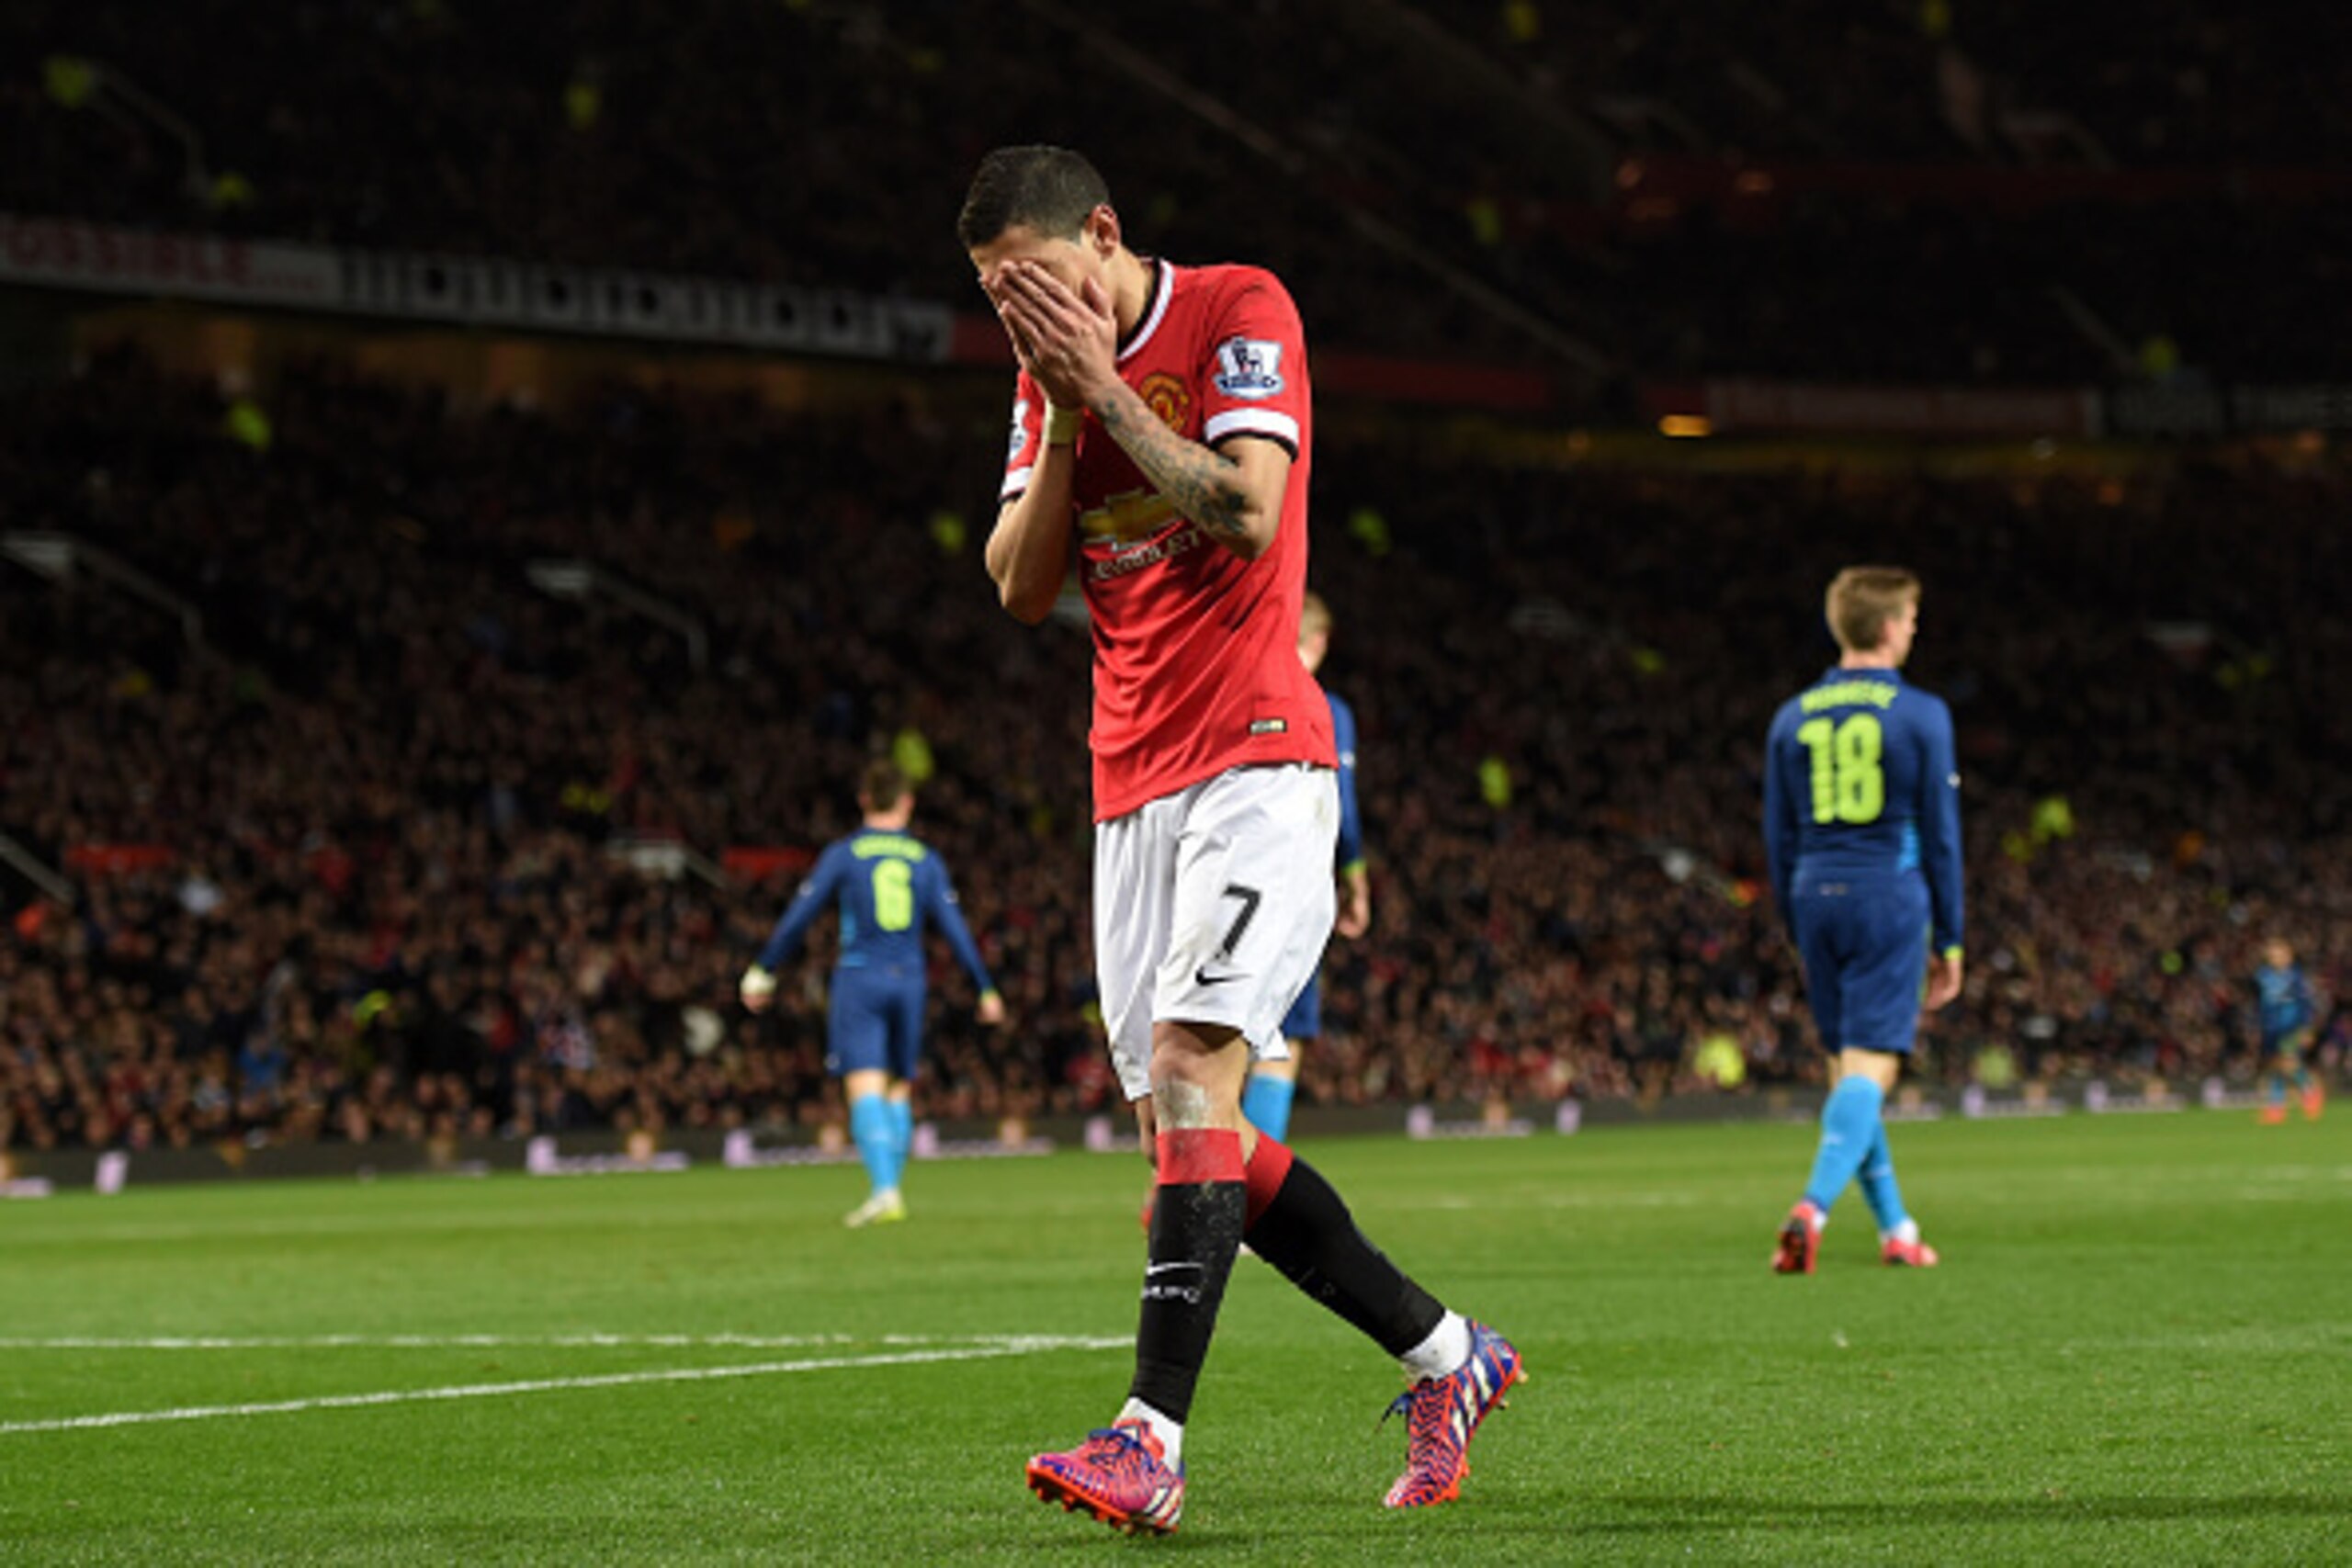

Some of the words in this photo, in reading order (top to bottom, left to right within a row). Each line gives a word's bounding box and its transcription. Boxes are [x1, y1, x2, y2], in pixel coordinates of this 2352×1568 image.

[1798, 715, 1883, 823] 18
[873, 860, 911, 931] 6
[1216, 885, 1261, 962] 7
